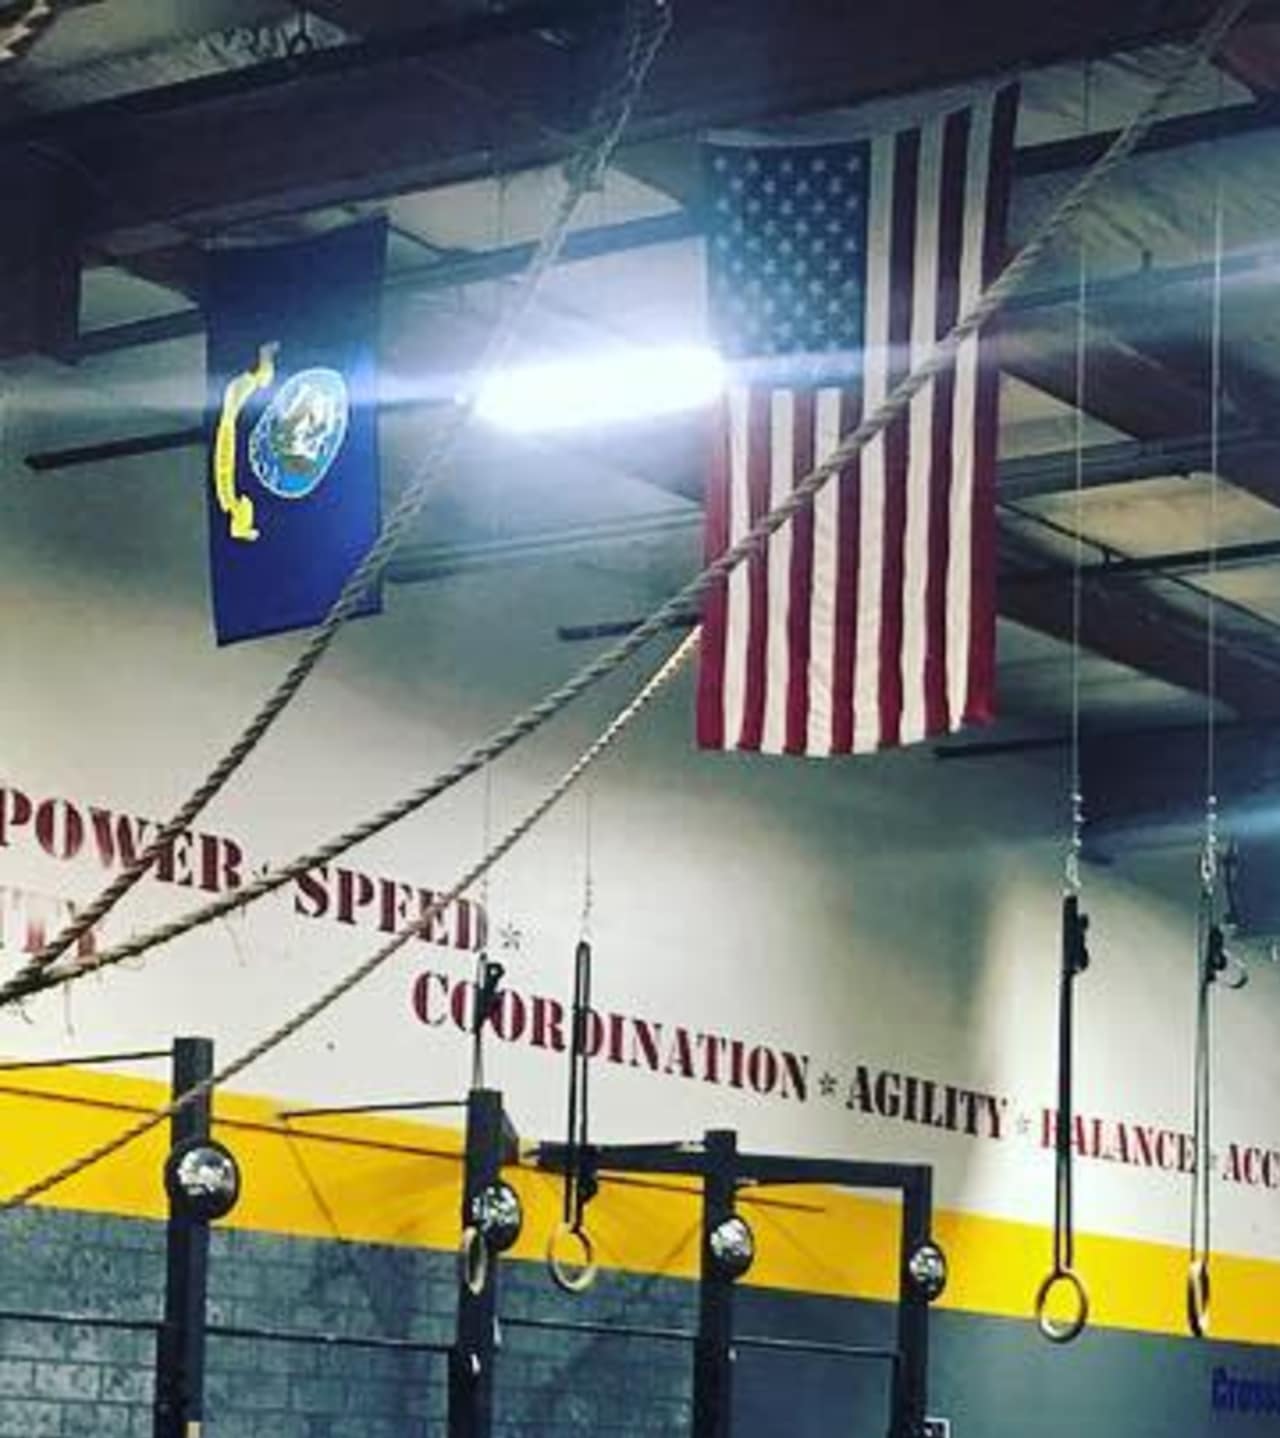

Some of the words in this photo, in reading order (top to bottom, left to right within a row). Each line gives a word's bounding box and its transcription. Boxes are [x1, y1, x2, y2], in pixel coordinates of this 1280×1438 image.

[0, 786, 244, 893] POWER
[294, 865, 489, 953] SPEED
[412, 969, 811, 1104] COORDINATION
[845, 1065, 1008, 1139] AGILITY
[1041, 1107, 1199, 1174] BALANCE
